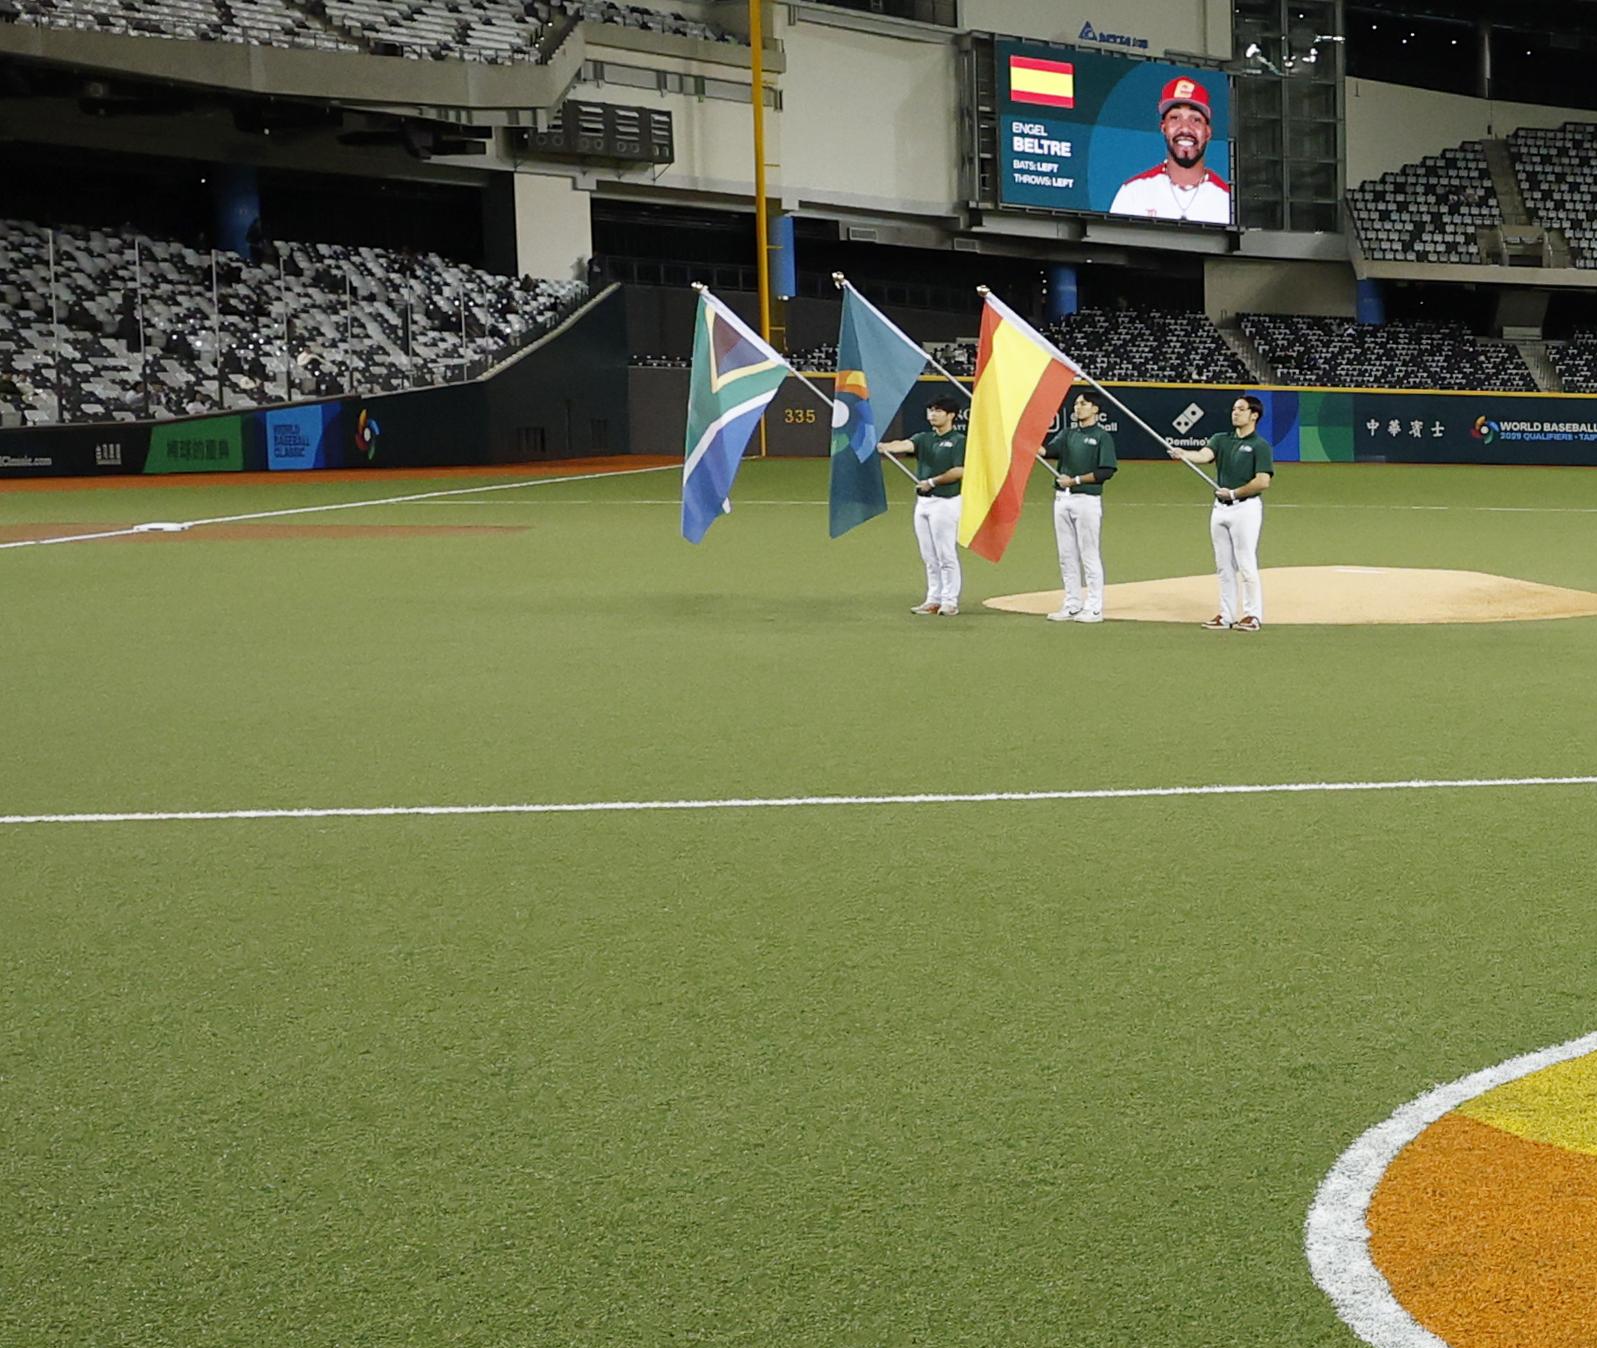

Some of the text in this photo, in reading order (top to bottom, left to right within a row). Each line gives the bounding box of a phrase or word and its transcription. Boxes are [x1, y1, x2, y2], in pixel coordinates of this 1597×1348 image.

[1012, 122, 1048, 136] ENGEL
[1013, 136, 1072, 157] BELTRE
[1013, 159, 1059, 173] BATS: LEFT
[1013, 173, 1074, 188] THROWS: LEFT
[784, 409, 816, 424] 335
[1500, 421, 1541, 432] WORLD
[1165, 437, 1209, 447] Domino'
